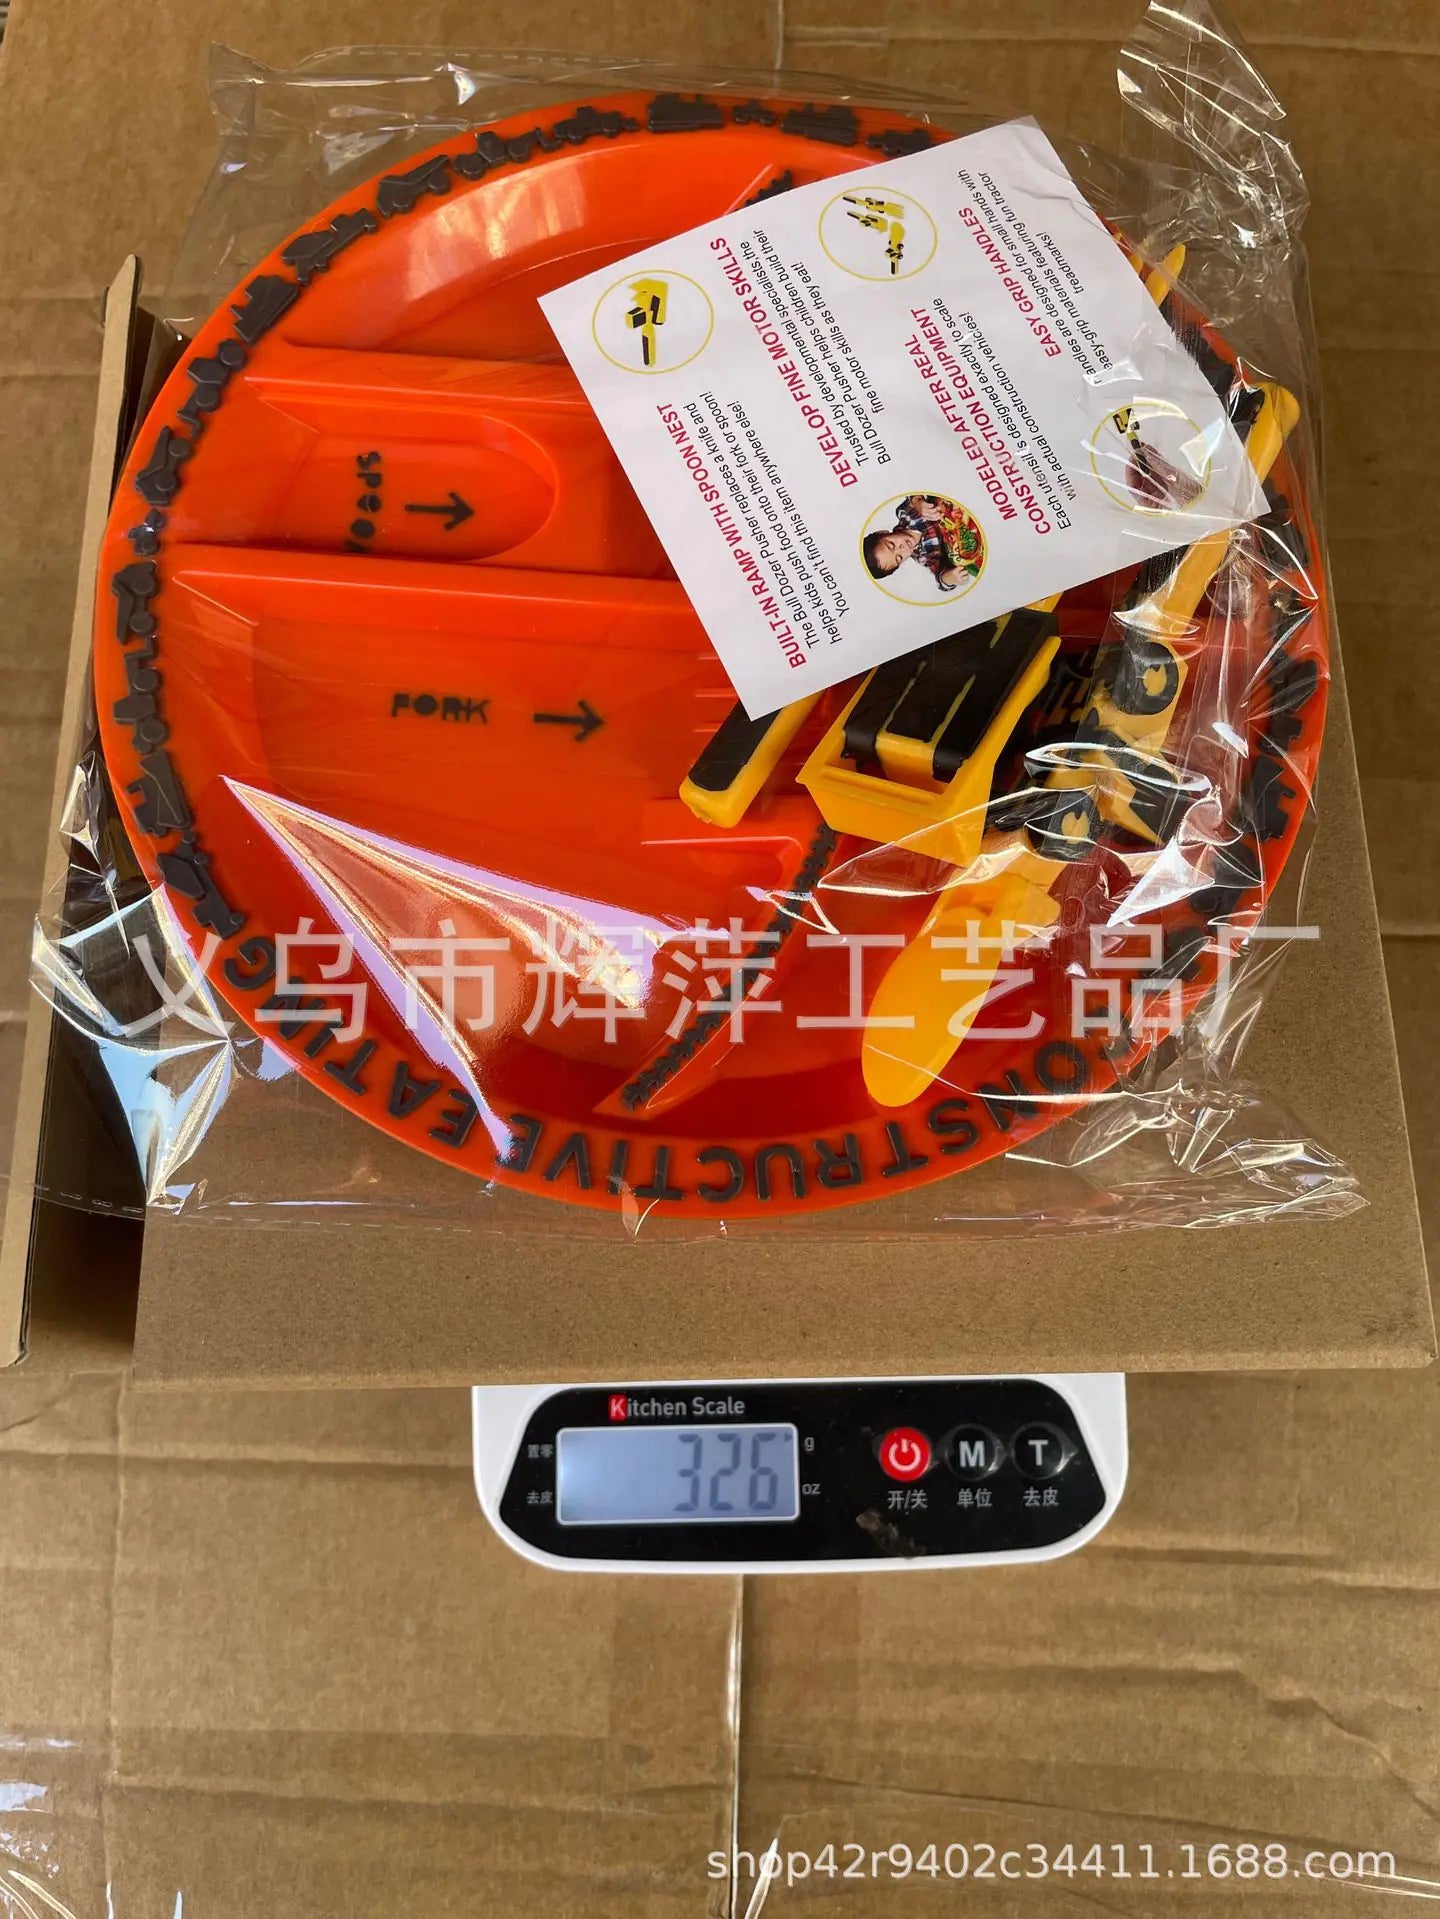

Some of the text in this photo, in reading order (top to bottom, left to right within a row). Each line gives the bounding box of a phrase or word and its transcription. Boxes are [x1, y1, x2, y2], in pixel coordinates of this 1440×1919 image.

[956, 168, 977, 192] with
[971, 190, 999, 224] hands
[989, 222, 1018, 251] small
[976, 171, 1113, 370] easy-grip materials featuring fun tractor
[1010, 251, 1028, 268] for
[1034, 230, 1085, 295] treadmarks!
[957, 206, 1062, 358] EASY GRIP HANDLES
[1019, 266, 1059, 318] designed
[931, 297, 957, 329] scale
[1054, 317, 1073, 338] are
[751, 228, 892, 465] Bull Dozer Pusher helps children build their
[789, 260, 885, 414] fine motor skills as they eat!
[950, 328, 964, 343] to
[708, 236, 859, 489] DEVELOP FINE MOTOR SKILLS
[779, 317, 836, 403] developmental
[957, 343, 989, 384] exactly
[725, 399, 751, 429] else!
[828, 402, 845, 420] by
[979, 384, 1022, 439] designed
[990, 361, 1040, 434] construction
[903, 332, 1018, 521] MODELED AFTER REAL
[909, 307, 1052, 535] CONSTRUCTION EQUIPMENT
[744, 428, 782, 486] anywhere
[834, 418, 870, 467] Trusted
[1030, 433, 1063, 472] actual
[1019, 451, 1053, 494] utensil
[1055, 472, 1077, 501] with
[774, 485, 797, 515] item
[1045, 493, 1072, 530] Each
[681, 401, 821, 650] The Bull Dozer Pusher replaces a knife and
[697, 390, 843, 645] helps kids push food onto their fork or spoon!
[789, 512, 809, 537] this
[655, 402, 807, 669] BUILT-IN RAMP WITH SPOON NEST
[798, 535, 822, 561] find
[830, 589, 850, 618] You
[391, 692, 492, 725] FORK
[224, 936, 481, 1148] EATING
[610, 1396, 746, 1418] Kitchen Scale
[804, 1436, 815, 1452] g
[958, 1440, 985, 1468] M
[1027, 1439, 1049, 1466] T
[673, 1432, 779, 1512] 326
[526, 1489, 554, 1504] 去皮
[802, 1483, 821, 1496] oz
[887, 1488, 929, 1510] 开/关
[956, 1487, 993, 1508] 单位
[1022, 1486, 1060, 1508] 去皮
